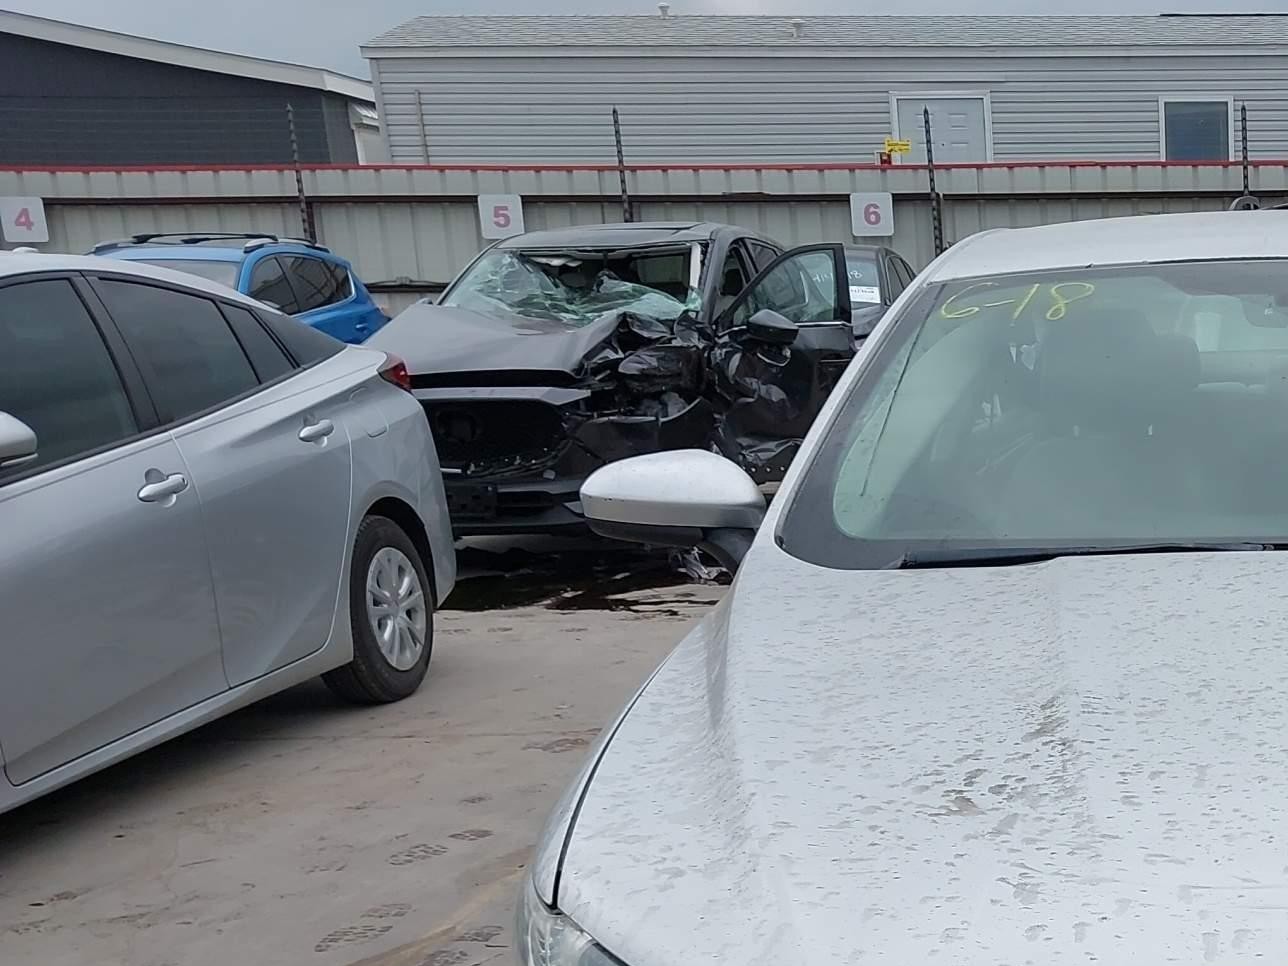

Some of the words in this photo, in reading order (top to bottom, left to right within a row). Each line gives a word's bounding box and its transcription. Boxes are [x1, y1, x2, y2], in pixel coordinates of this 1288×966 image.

[15, 208, 35, 231] 4
[493, 206, 510, 228] 5
[864, 203, 881, 225] 6
[941, 281, 1095, 321] 6-18
